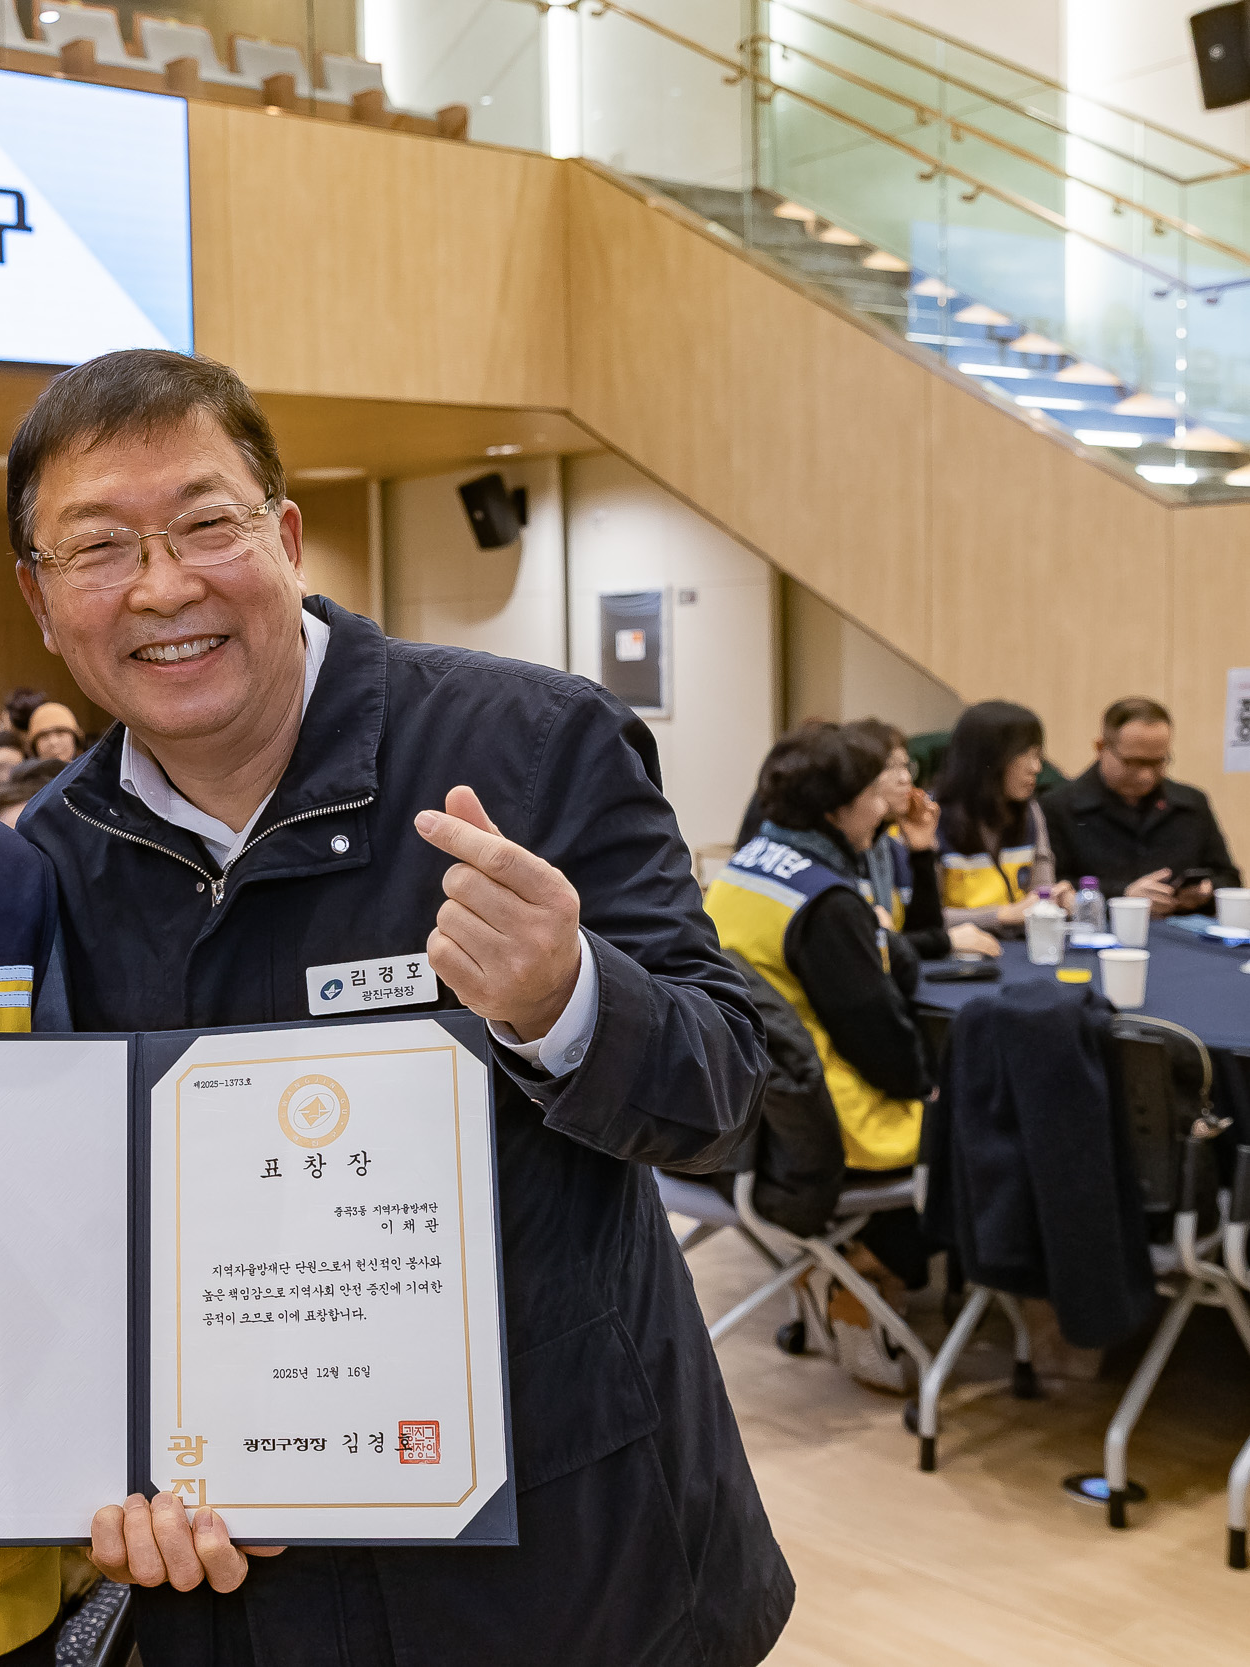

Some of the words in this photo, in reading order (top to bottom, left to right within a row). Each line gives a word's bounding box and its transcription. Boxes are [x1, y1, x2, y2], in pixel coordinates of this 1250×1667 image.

[361, 985, 415, 1001] 광진구청장
[193, 1077, 252, 1089] 제2025-1373호
[333, 1205, 367, 1218] 중곡3동
[372, 1201, 439, 1216] 지역자율방재단
[212, 1261, 291, 1278] 지역자율방재단
[295, 1258, 351, 1275] 단원으로서
[355, 1256, 401, 1272] 헌신적인
[405, 1255, 442, 1271] 봉사와
[202, 1288, 226, 1303] 높은
[228, 1286, 286, 1301] 책임감으로
[289, 1283, 335, 1299] 지역사회
[339, 1282, 362, 1297] 안전
[366, 1281, 401, 1297] 증진에
[406, 1279, 443, 1294] 기여한
[202, 1311, 235, 1327] 공적이
[239, 1311, 275, 1324] 크므로
[277, 1309, 300, 1324] 이에
[304, 1307, 367, 1323] 표창합니다.
[272, 1366, 308, 1380] 2025년
[316, 1365, 339, 1379] 12월
[347, 1365, 370, 1379] 16일
[242, 1437, 328, 1453] 광진구청장
